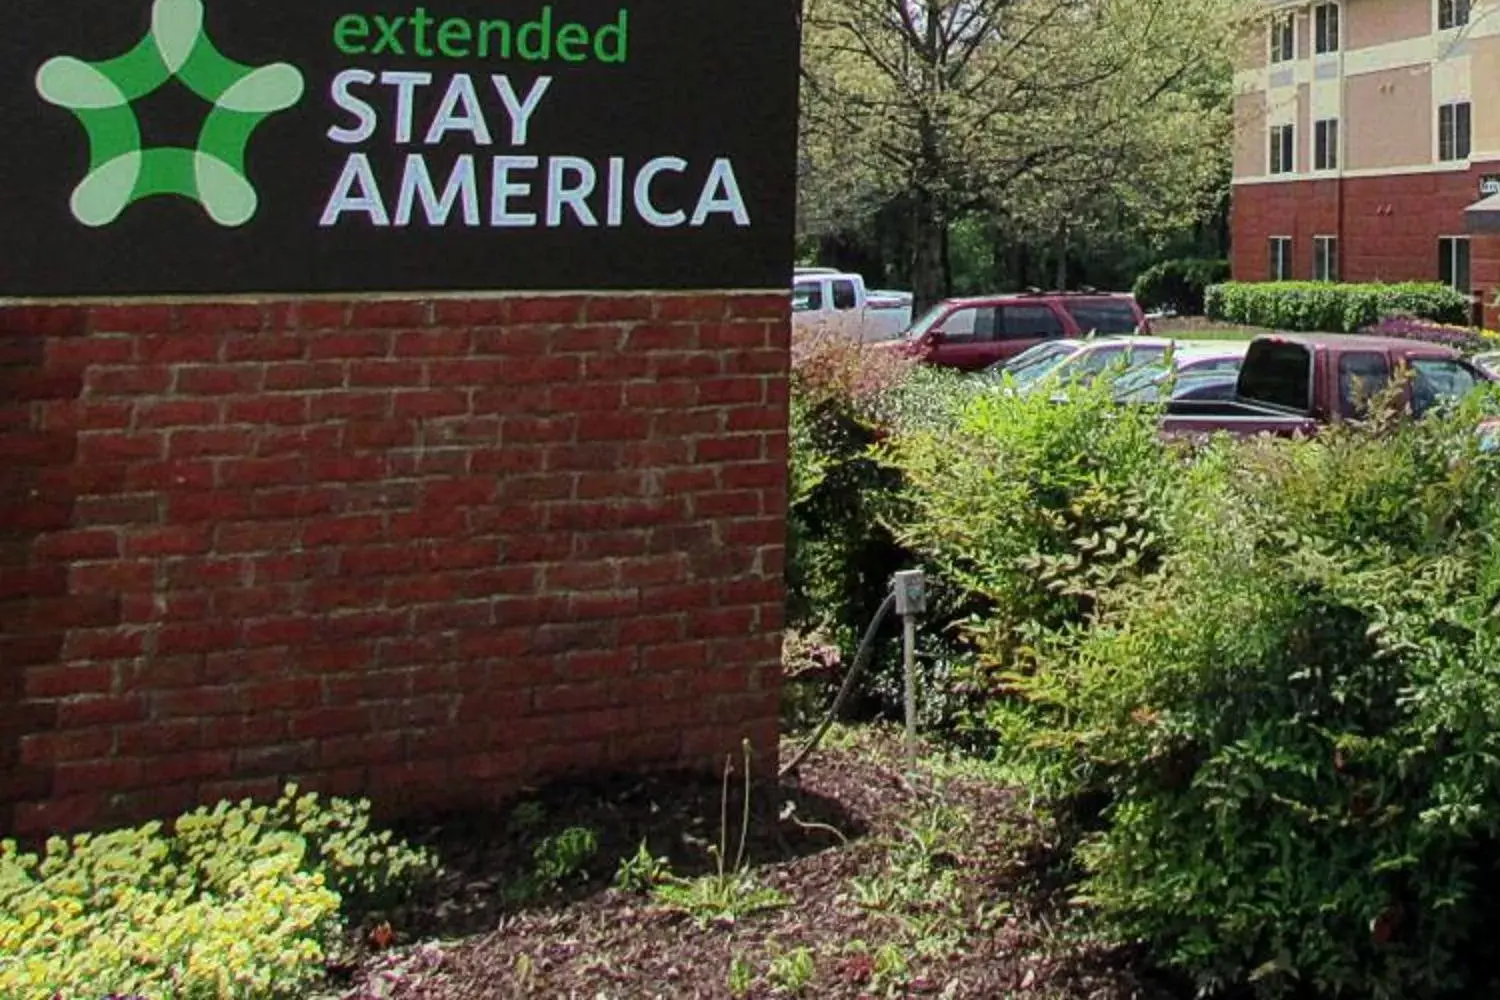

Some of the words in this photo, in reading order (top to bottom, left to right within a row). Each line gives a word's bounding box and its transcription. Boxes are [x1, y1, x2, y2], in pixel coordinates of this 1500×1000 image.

[334, 6, 627, 62] extended
[327, 69, 553, 146] STAY
[320, 153, 751, 227] AMERICA
